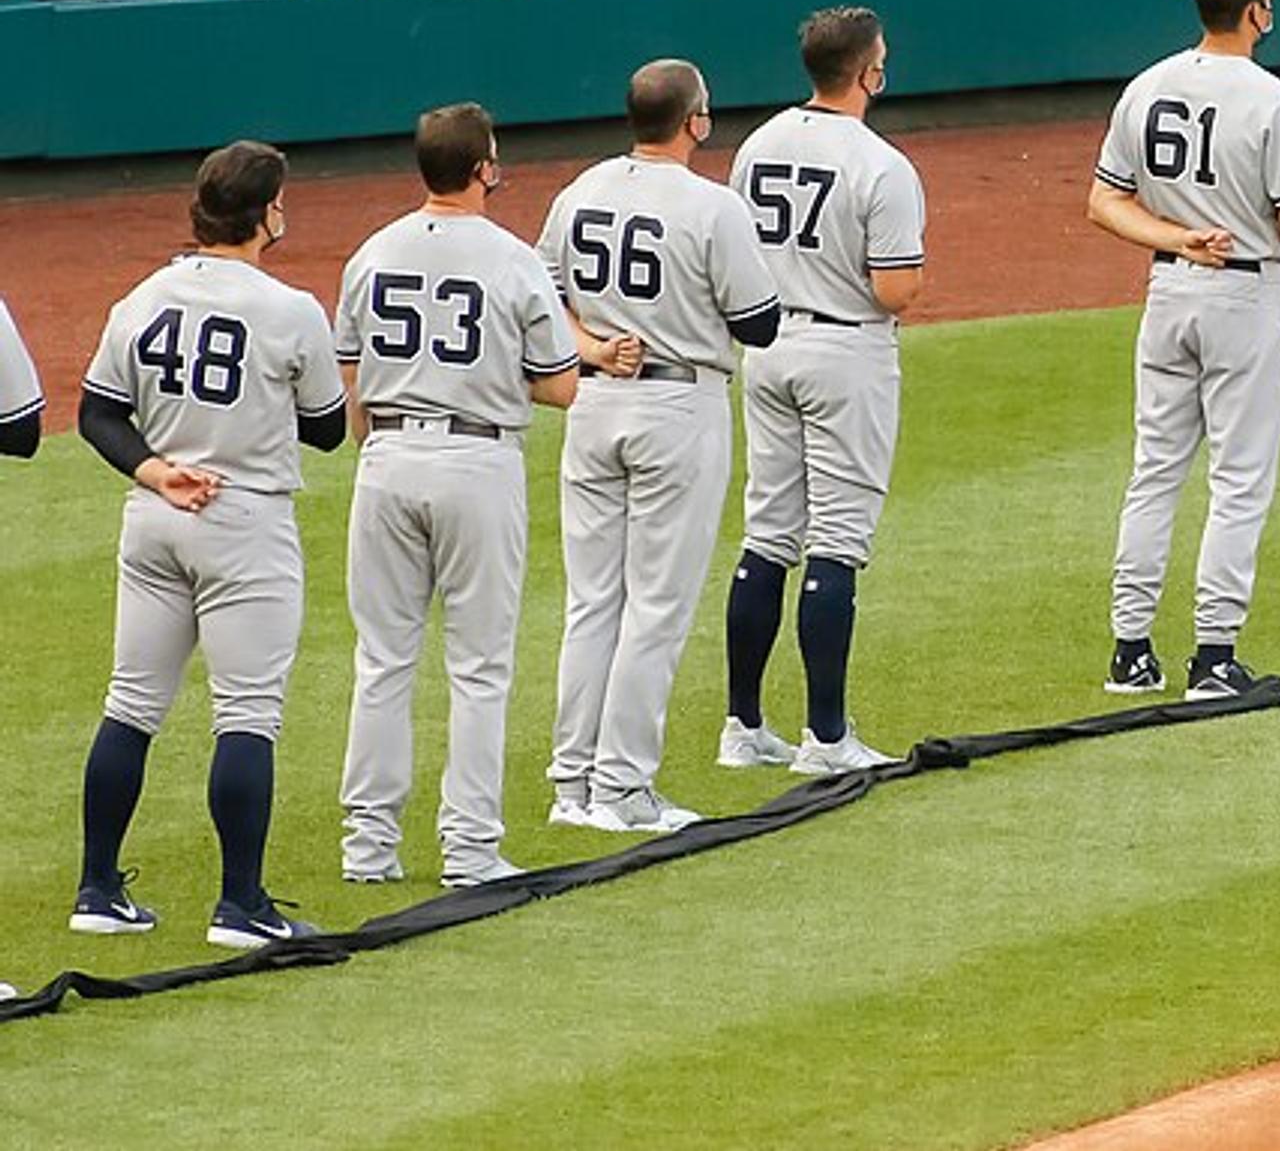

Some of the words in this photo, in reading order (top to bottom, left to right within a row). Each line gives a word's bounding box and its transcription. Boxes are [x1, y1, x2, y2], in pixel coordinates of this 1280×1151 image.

[1144, 97, 1218, 187] 61
[749, 162, 838, 250] 57
[571, 207, 664, 301] 56
[136, 306, 249, 408] 48
[370, 271, 486, 369] 53
